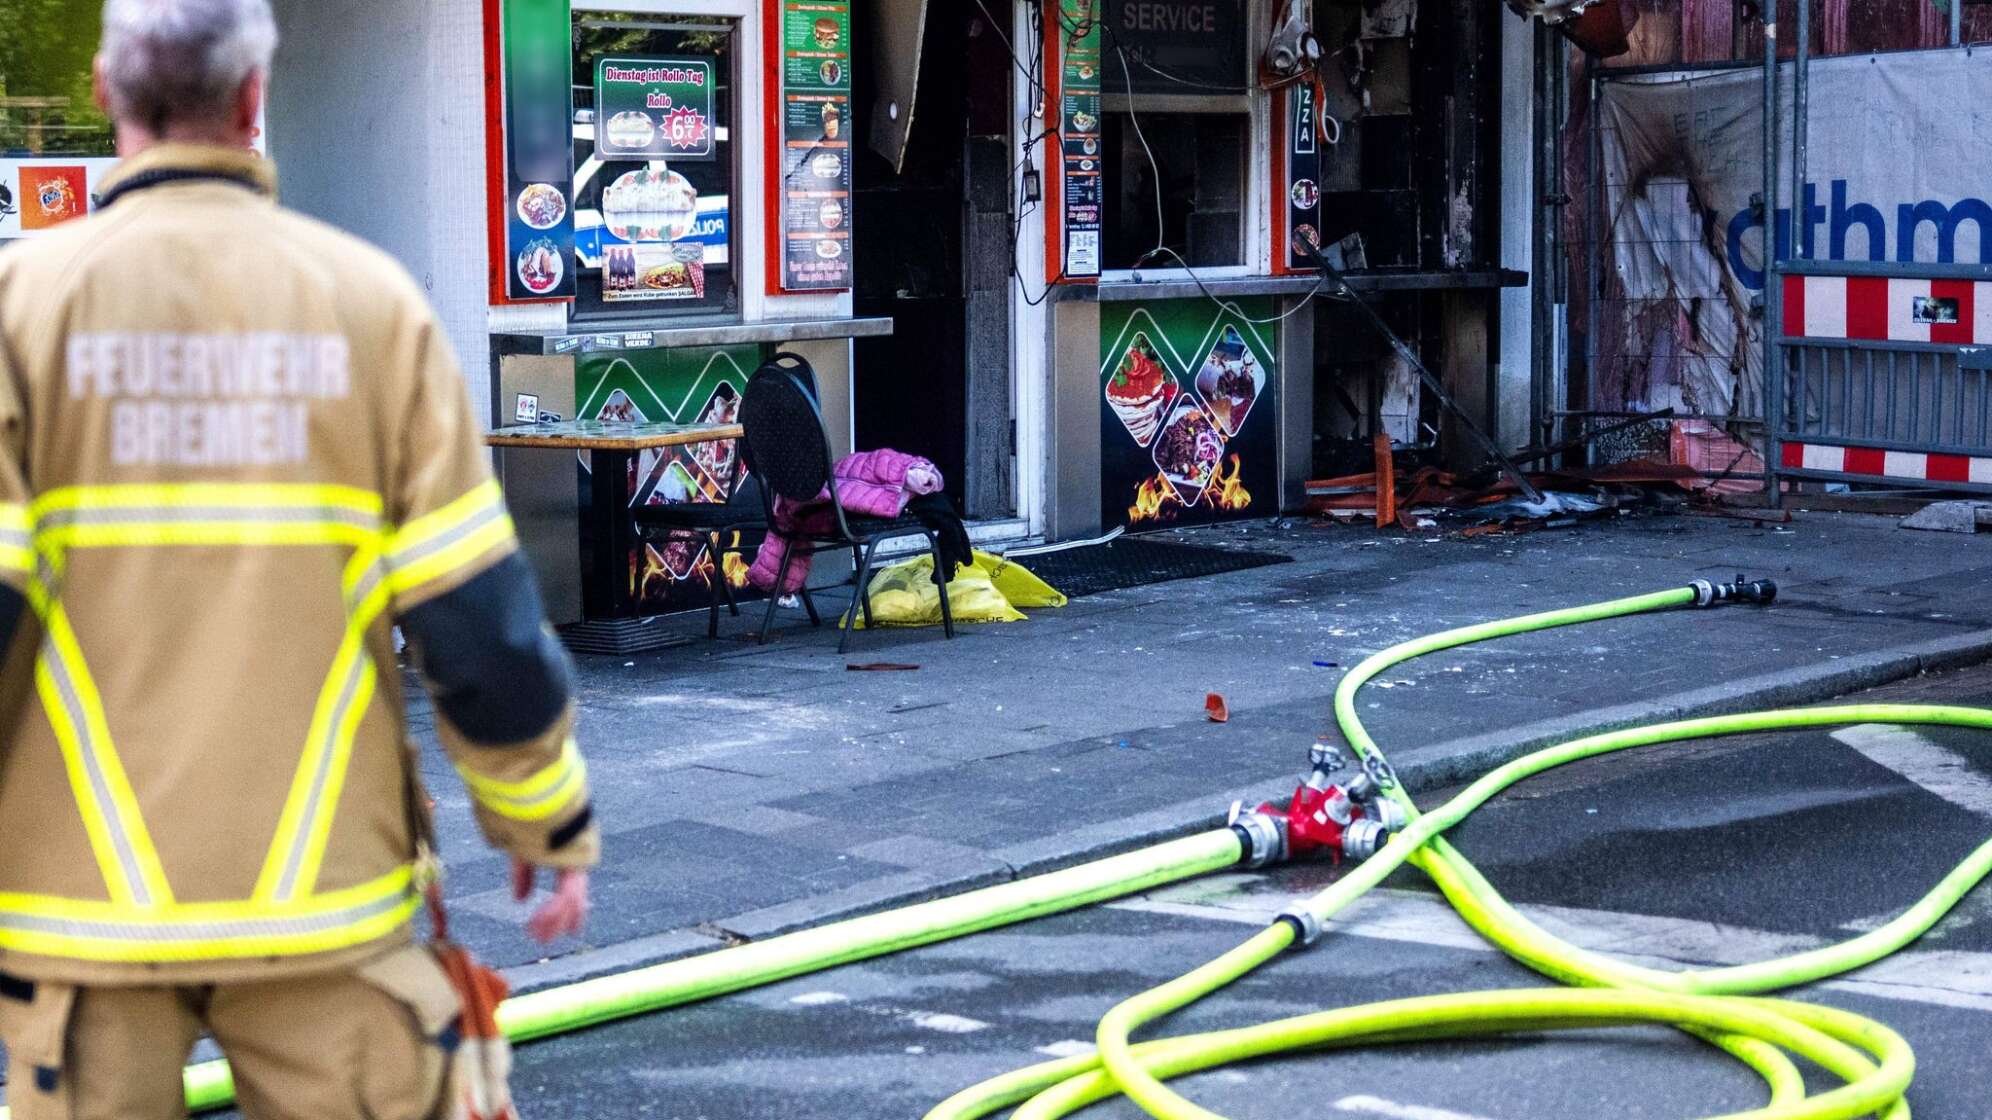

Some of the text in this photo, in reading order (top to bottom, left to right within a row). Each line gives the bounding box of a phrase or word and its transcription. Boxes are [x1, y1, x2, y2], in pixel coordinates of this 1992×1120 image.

[1123, 3, 1215, 32] SERVICE
[606, 67, 703, 86] Dienstag ist Rollo Tag
[646, 93, 672, 108] Rollo
[66, 332, 350, 398] FEUERWEHR
[111, 401, 309, 464] BREMEN
